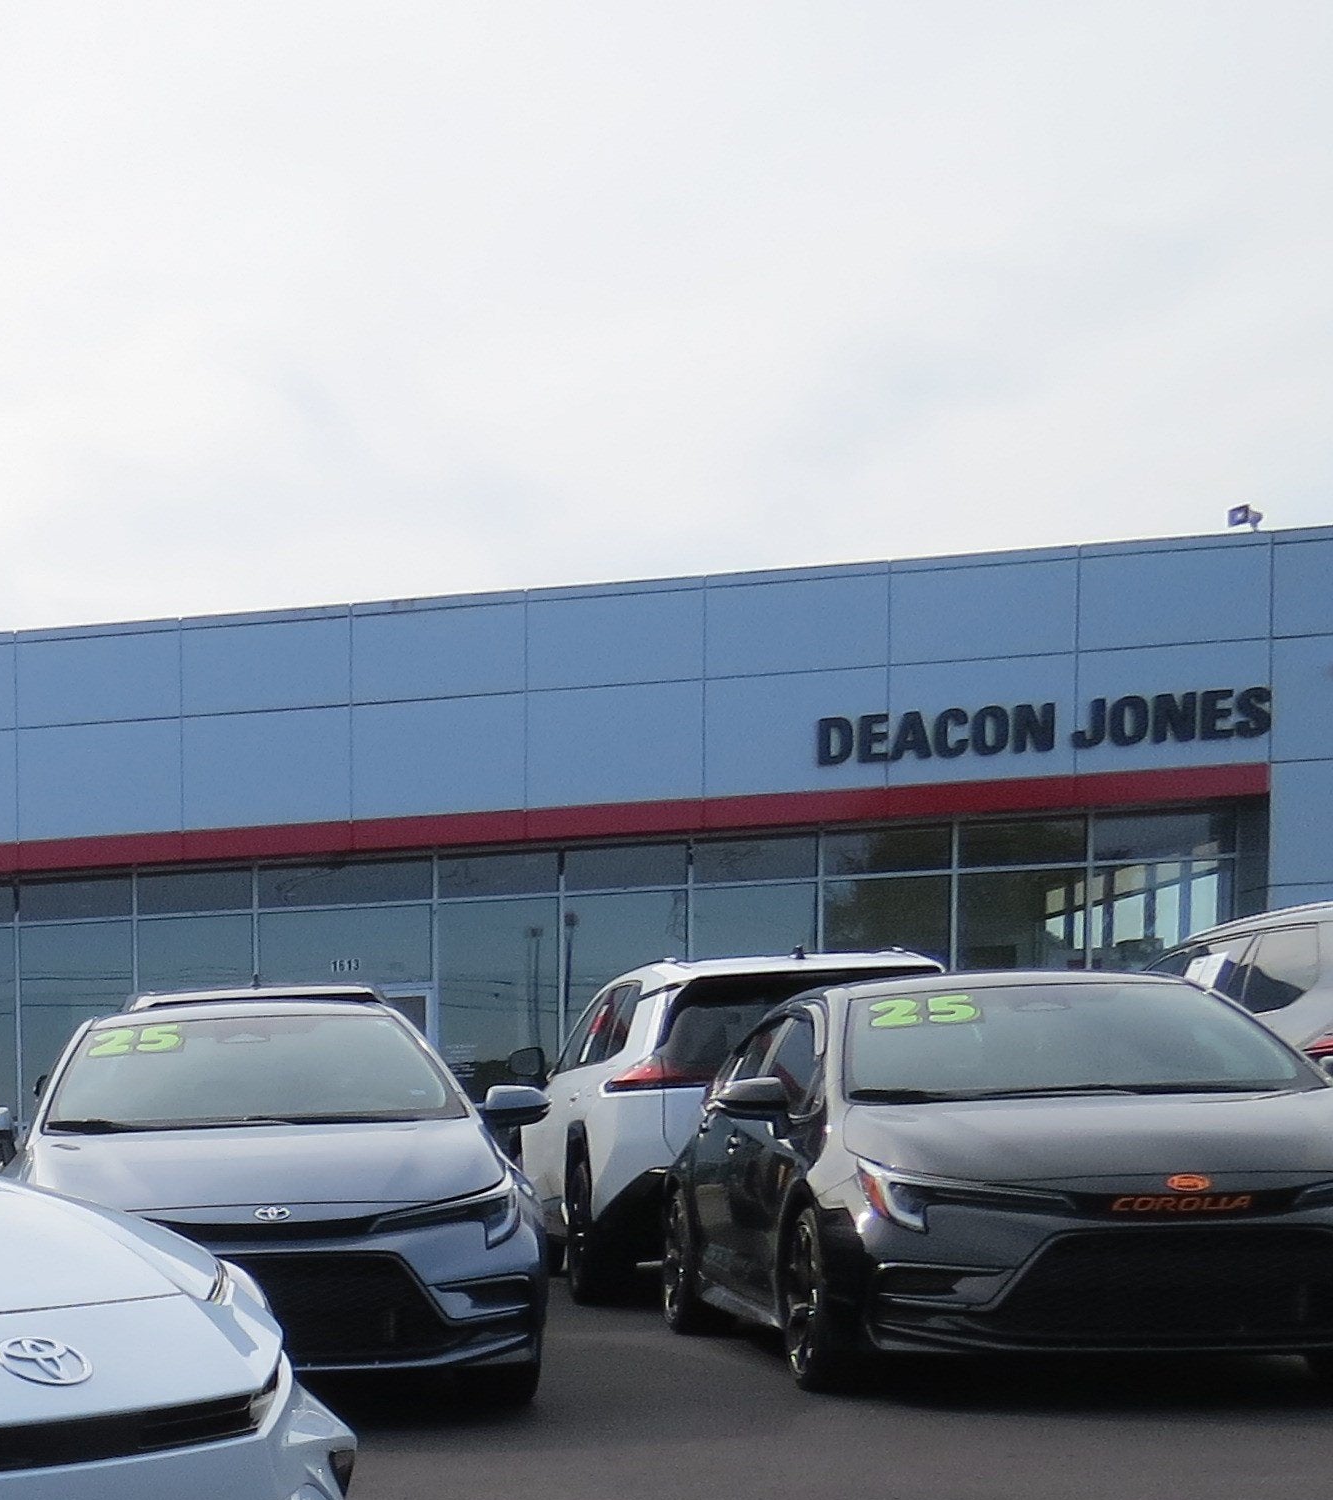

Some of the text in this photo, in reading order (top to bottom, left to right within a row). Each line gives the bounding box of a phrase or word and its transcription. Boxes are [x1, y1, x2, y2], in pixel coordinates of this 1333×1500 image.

[816, 686, 1272, 766] DEACON JONES
[331, 958, 360, 973] 1613
[868, 993, 981, 1029] 25
[87, 1024, 183, 1058] 25
[1111, 1195, 1252, 1212] COROLLA
